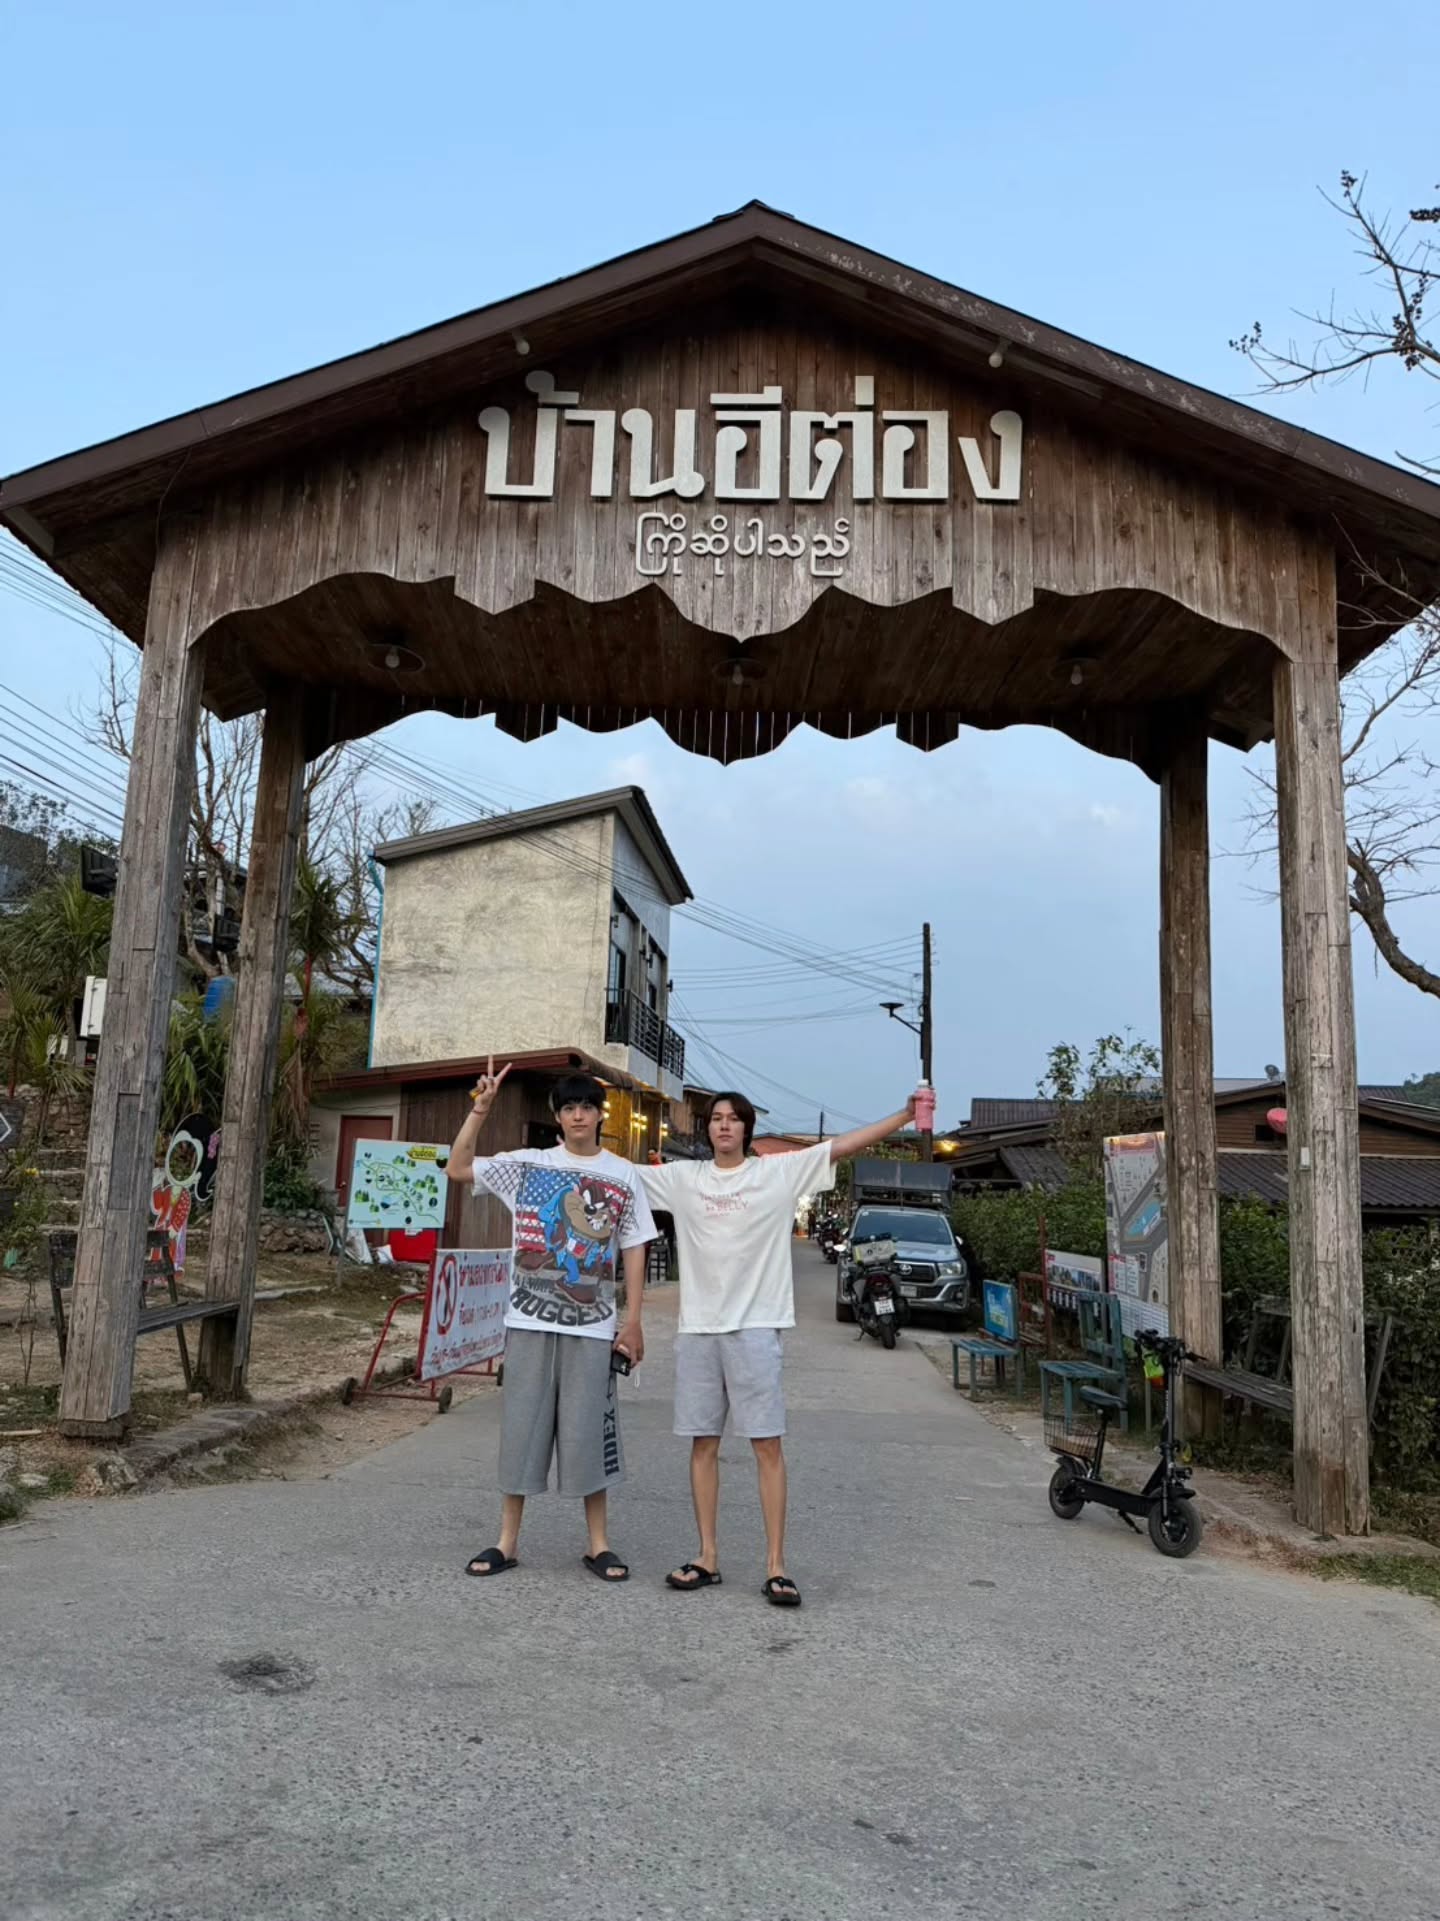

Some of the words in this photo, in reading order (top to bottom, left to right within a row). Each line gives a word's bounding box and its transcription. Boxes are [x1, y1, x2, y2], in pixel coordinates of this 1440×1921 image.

[478, 370, 1023, 499] บ้านอีต่อง
[635, 511, 851, 577] ကြိုဆိုပါသည်
[510, 1287, 613, 1327] RUGGED
